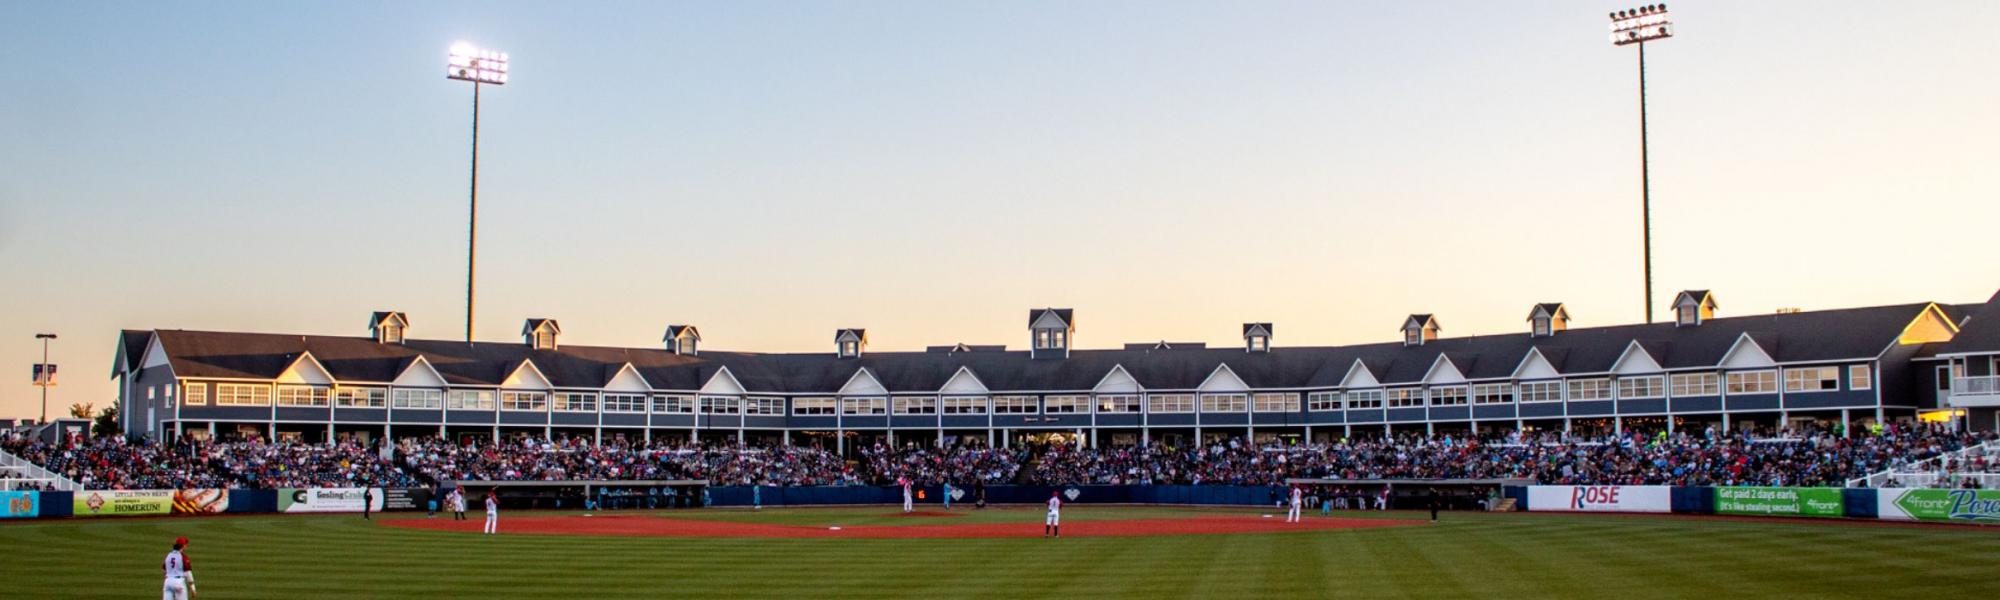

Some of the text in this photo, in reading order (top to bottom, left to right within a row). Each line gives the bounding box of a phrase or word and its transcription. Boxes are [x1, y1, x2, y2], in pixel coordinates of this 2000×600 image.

[918, 490, 925, 499] 6
[1571, 486, 1620, 509] ROSE
[1720, 488, 1799, 502] Get paid 2 days early.
[1906, 495, 1945, 508] 4front
[114, 503, 161, 513] HOMERUN!
[170, 557, 176, 569] 5
